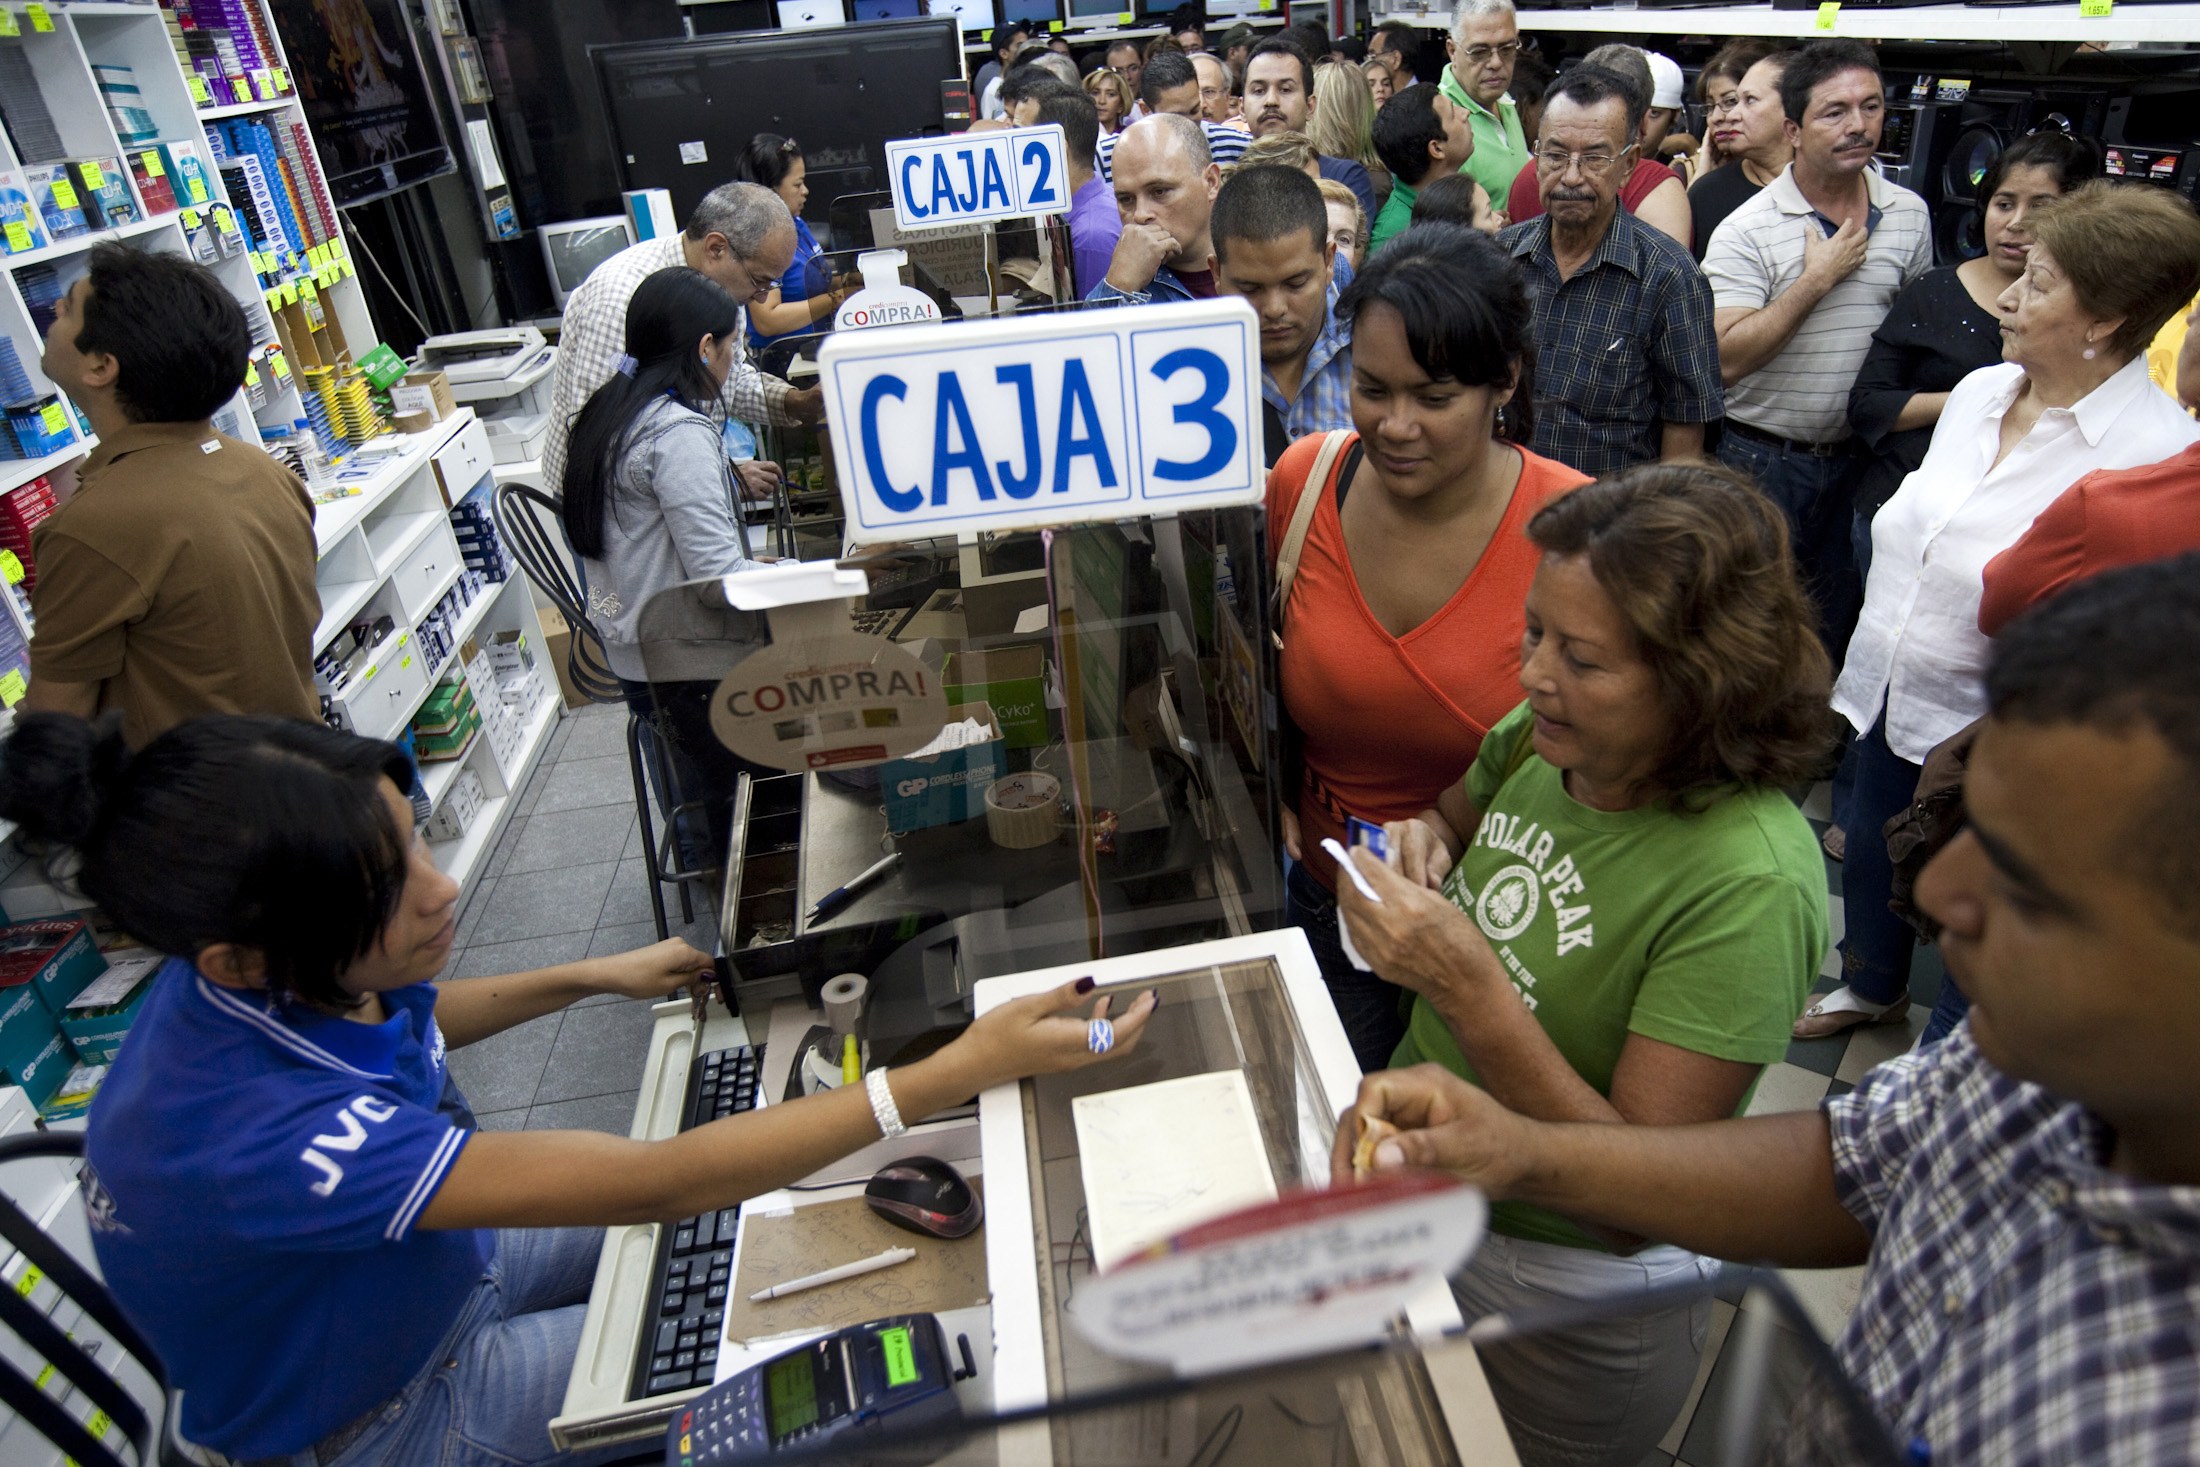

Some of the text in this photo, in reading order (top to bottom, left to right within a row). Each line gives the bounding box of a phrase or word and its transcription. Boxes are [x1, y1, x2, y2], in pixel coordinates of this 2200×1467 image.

[29, 172, 50, 183] PHILIPS
[902, 141, 1055, 218] CAJA 2
[45, 213, 76, 231] CD-R
[842, 304, 932, 327] COMPRA!
[860, 347, 1238, 514] CAJA 3
[494, 663, 519, 672] Energizer
[726, 670, 928, 717] COMPRA!
[897, 777, 928, 798] GP
[1475, 811, 1554, 872] POLAR
[1541, 854, 1594, 957] PEAK
[73, 1036, 91, 1046] GP
[22, 1061, 37, 1081] GP
[301, 1095, 399, 1197] JVC
